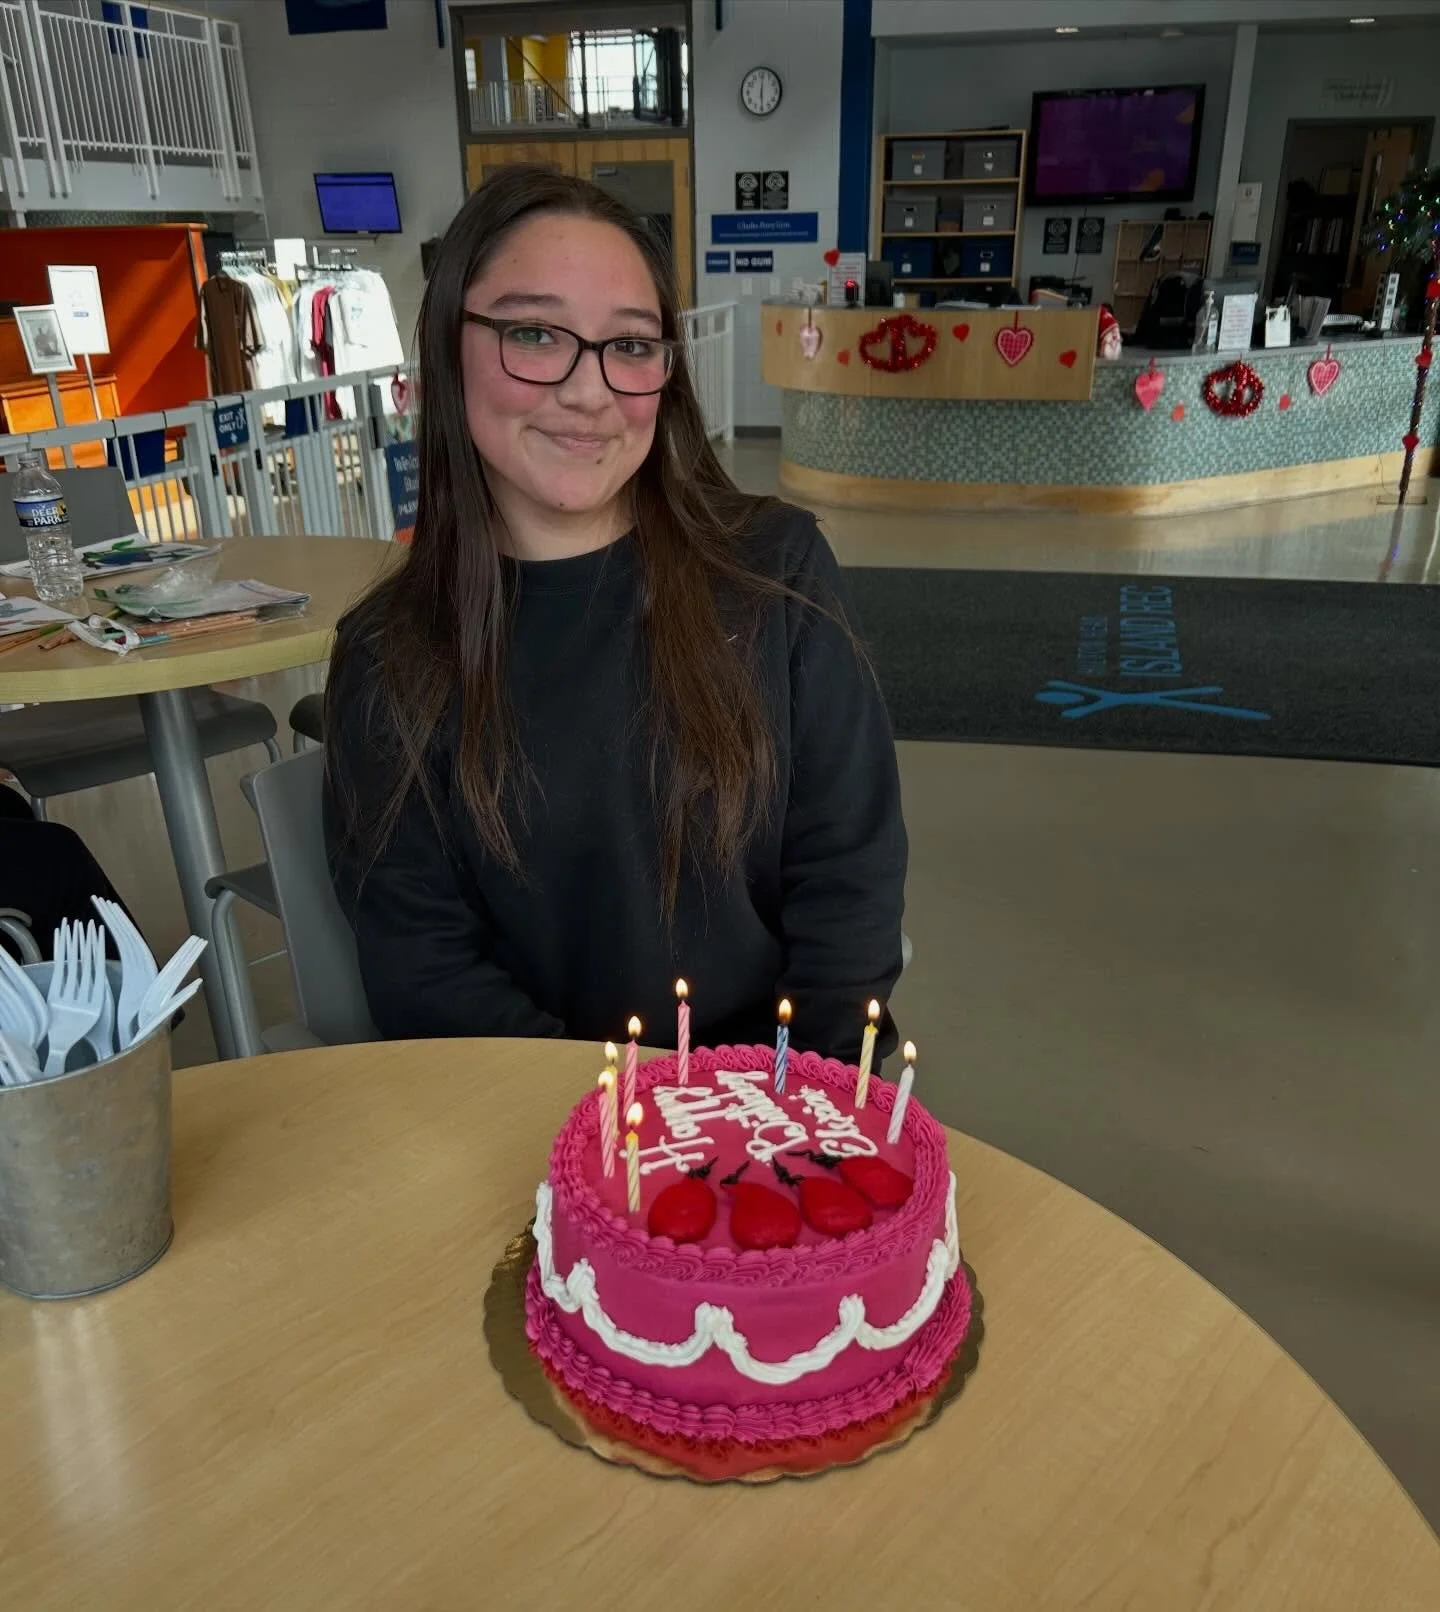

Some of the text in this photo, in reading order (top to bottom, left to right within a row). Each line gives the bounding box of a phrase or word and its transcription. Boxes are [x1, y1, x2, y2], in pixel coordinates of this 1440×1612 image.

[735, 257, 749, 266] NO
[751, 256, 772, 266] GUM
[219, 411, 234, 424] EXIT
[219, 421, 236, 434] ONLY
[31, 506, 59, 517] DEER
[33, 514, 62, 526] PARK
[1120, 617, 1182, 677] ISLAND
[714, 1070, 809, 1166] Birthday
[618, 1085, 728, 1175] Happy
